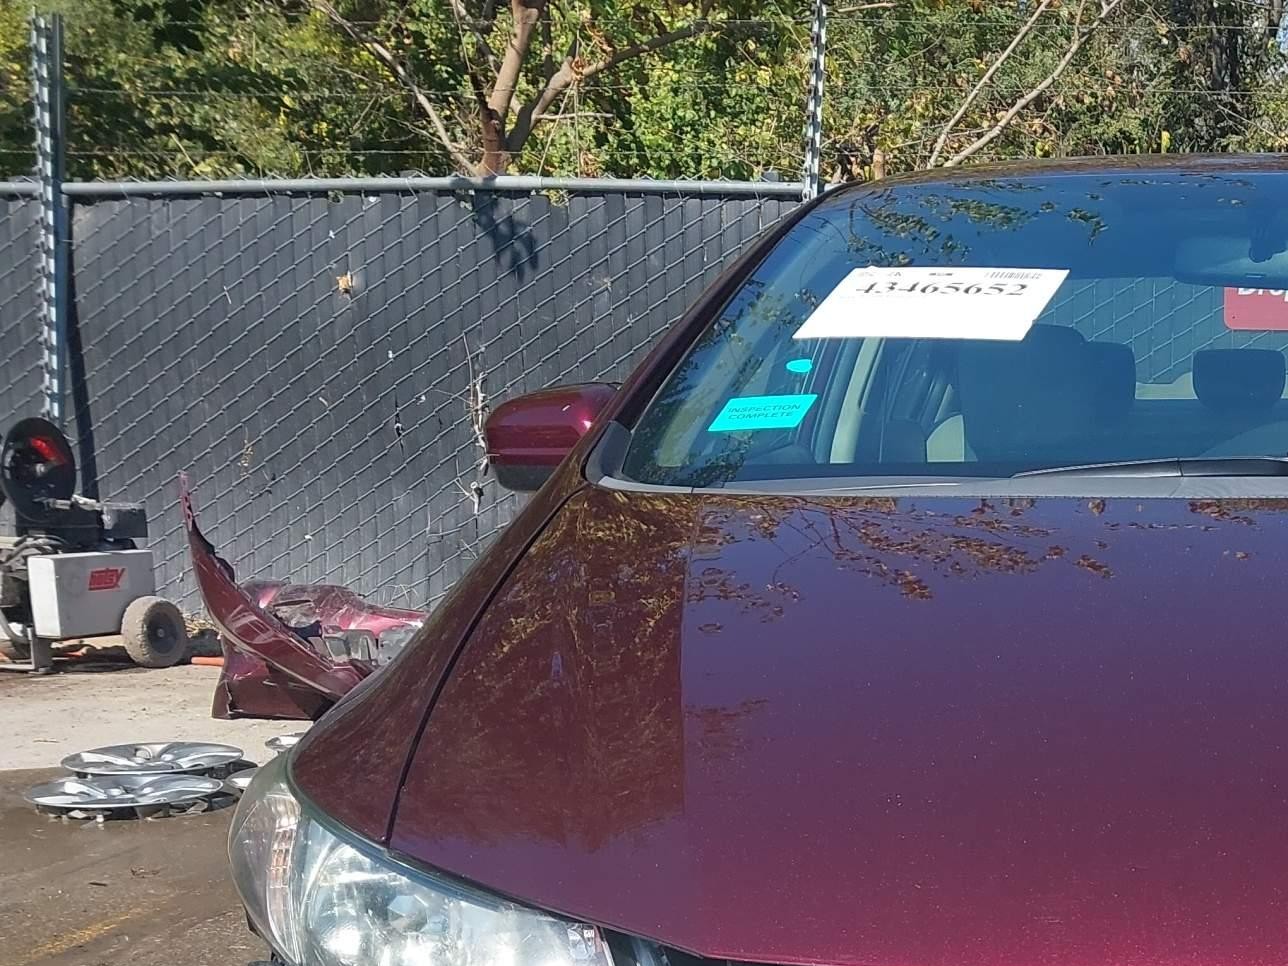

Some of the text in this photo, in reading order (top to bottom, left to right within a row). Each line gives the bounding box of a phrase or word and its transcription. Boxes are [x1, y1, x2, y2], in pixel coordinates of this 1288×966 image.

[855, 281, 1028, 296] 43465652
[728, 404, 801, 413] INSPECTION
[728, 411, 794, 420] COMPLETE
